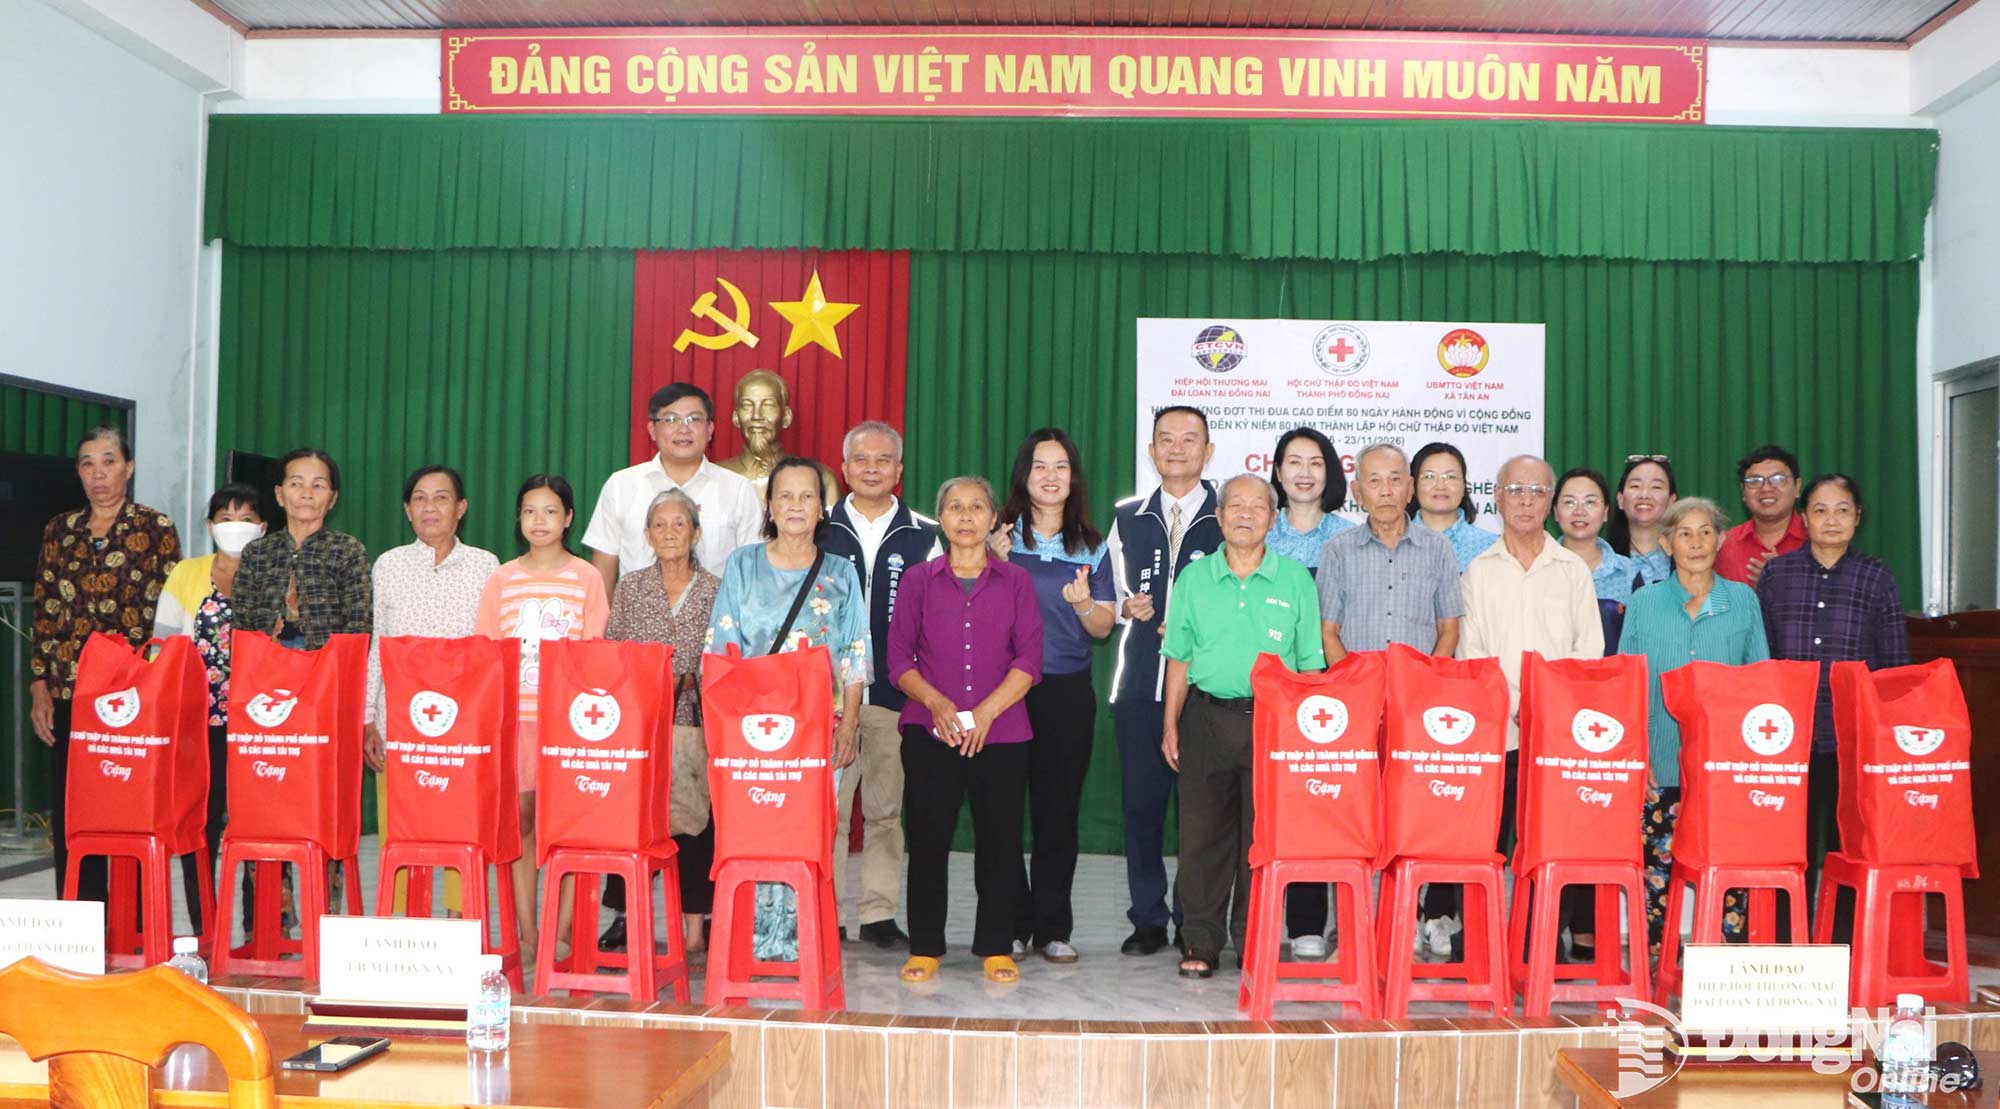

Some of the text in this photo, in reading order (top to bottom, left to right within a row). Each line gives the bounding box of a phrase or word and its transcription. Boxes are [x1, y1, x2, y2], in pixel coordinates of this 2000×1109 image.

[489, 41, 1661, 104] ĐẢNG CỘNG SẢN VIỆT NAM QUANG VINH MUÔN NĂM
[1195, 341, 1244, 351] CTCVN
[1380, 380, 1399, 388] NAM
[1484, 382, 1504, 390] NAM
[1188, 389, 1211, 397] LOAN
[1255, 389, 1270, 397] NAI
[1375, 391, 1390, 399] NAI
[1224, 406, 1246, 417] ĐỢT
[1248, 407, 1265, 416] THI
[1268, 407, 1289, 416] ĐUA
[1292, 408, 1314, 416] CAO
[1316, 404, 1343, 417] ĐIỂM
[1346, 408, 1358, 417] 80
[1361, 406, 1389, 418] NGÀY
[1392, 407, 1421, 418] HÀNH
[1423, 407, 1454, 420] ĐỘNG
[1456, 407, 1466, 418] VÌ
[1469, 408, 1498, 421] CỘNG
[1501, 406, 1531, 420] ĐỒNG
[1209, 417, 1232, 429] ĐẾN
[1235, 418, 1249, 429] KỶ
[1251, 419, 1277, 432] NIỆM
[1279, 420, 1291, 430] 80
[1319, 420, 1353, 430] THÀNH
[1356, 420, 1376, 433] LẬP
[1378, 420, 1396, 433] HỘI
[1398, 420, 1421, 431] CHỮ
[1423, 421, 1452, 435] THẬP
[1454, 421, 1470, 432] ĐỎ
[1471, 422, 1494, 435] VIỆT
[1495, 424, 1519, 433] NAM
